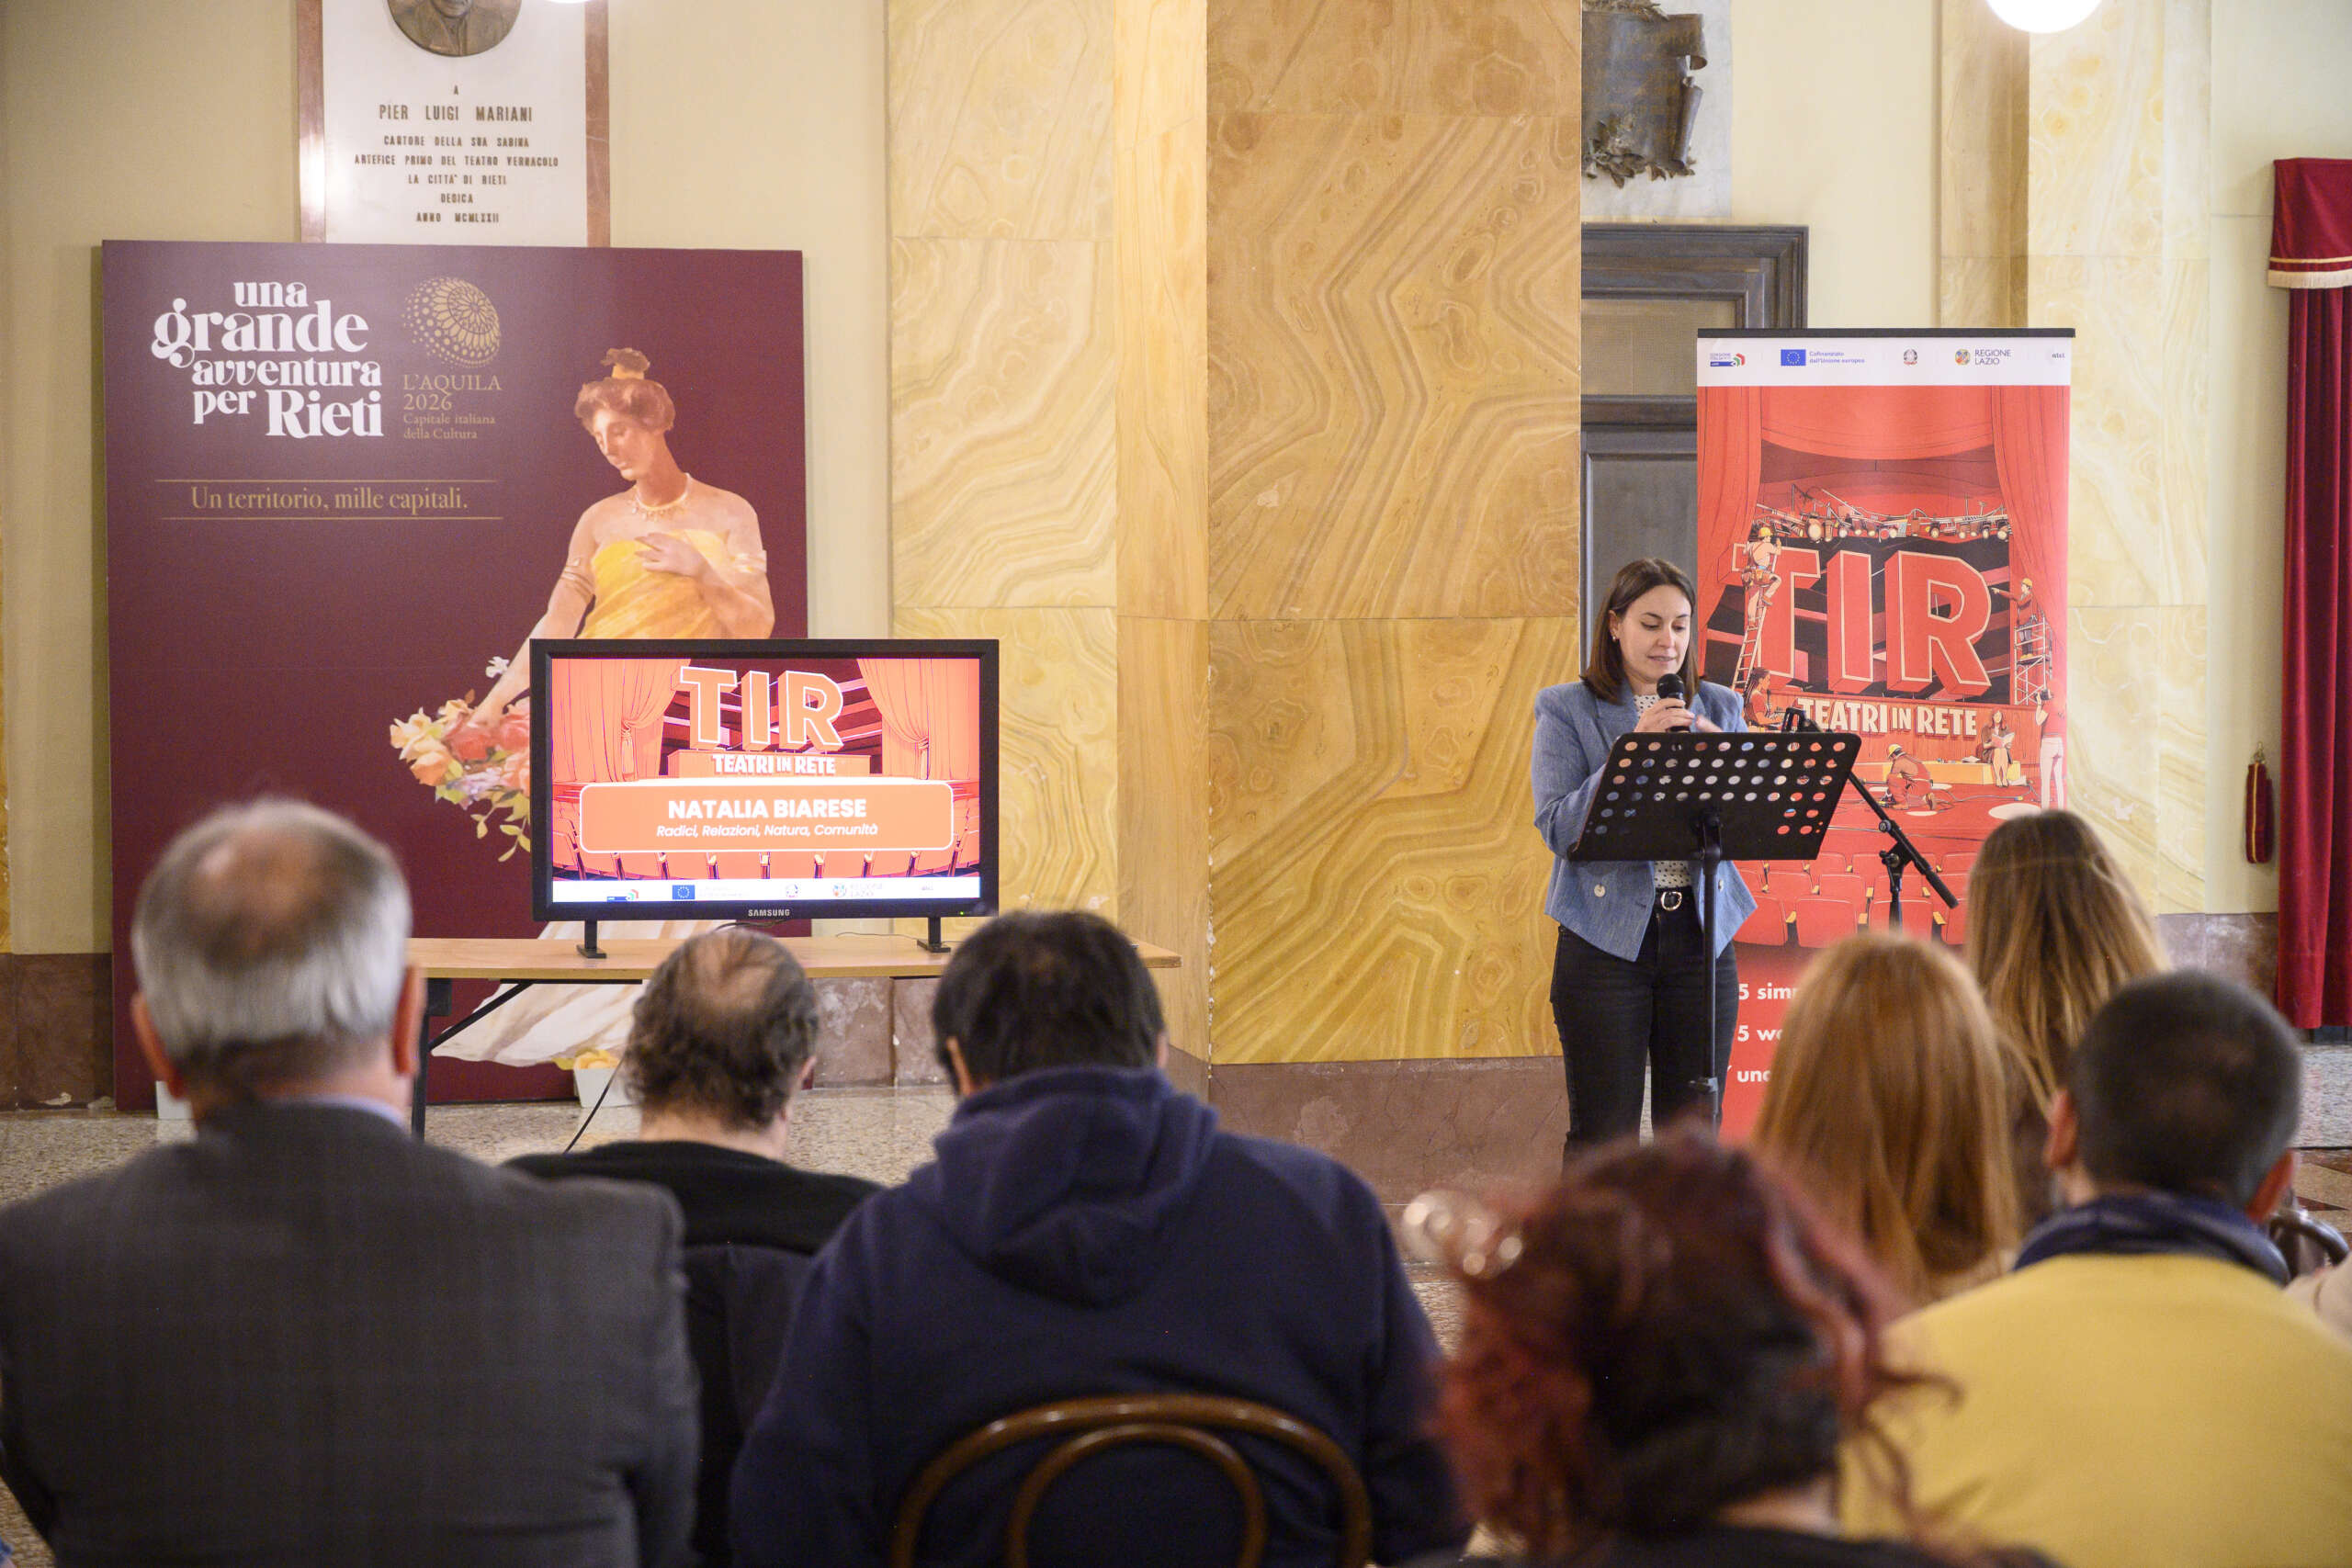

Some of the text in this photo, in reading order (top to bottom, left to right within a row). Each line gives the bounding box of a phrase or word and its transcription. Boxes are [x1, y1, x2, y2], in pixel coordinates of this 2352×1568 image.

[454, 85, 459, 96] A
[379, 105, 533, 122] PIER LUIGI MARIANI
[384, 136, 529, 147] CANTORE DELLA SUA SABINA
[354, 154, 559, 167] ARTEFICE PRIMO DEL TEATRO VERNACOLO
[408, 175, 419, 185] LA
[463, 175, 472, 185] DI
[482, 175, 507, 186] RIETI
[440, 194, 473, 204] DEDICA
[416, 212, 499, 223] ANNO MCMLXXII
[233, 281, 308, 308] una
[152, 298, 369, 367] grande
[1975, 349, 2011, 357] REGIONE
[1975, 357, 2000, 366] LAZIO
[191, 358, 382, 387] avventura
[404, 393, 453, 411] 2026
[193, 389, 384, 439] per Rieti
[404, 412, 450, 426] Capitale
[404, 427, 478, 439] della Cultura
[191, 486, 468, 515] Un territorio, mille capitali.
[1720, 543, 1992, 696] TIR
[675, 665, 844, 750] TIR
[1797, 697, 1978, 736] TEATRI IN RETE
[712, 754, 836, 774] TEATRI IN RETE
[669, 798, 867, 819] NATALIA BIARESE
[656, 823, 878, 838] Radici, Relazioni, Natura, Comunità
[748, 908, 790, 917] SAMSUNG
[1738, 983, 1749, 999] 5
[1737, 1025, 1749, 1042] 5
